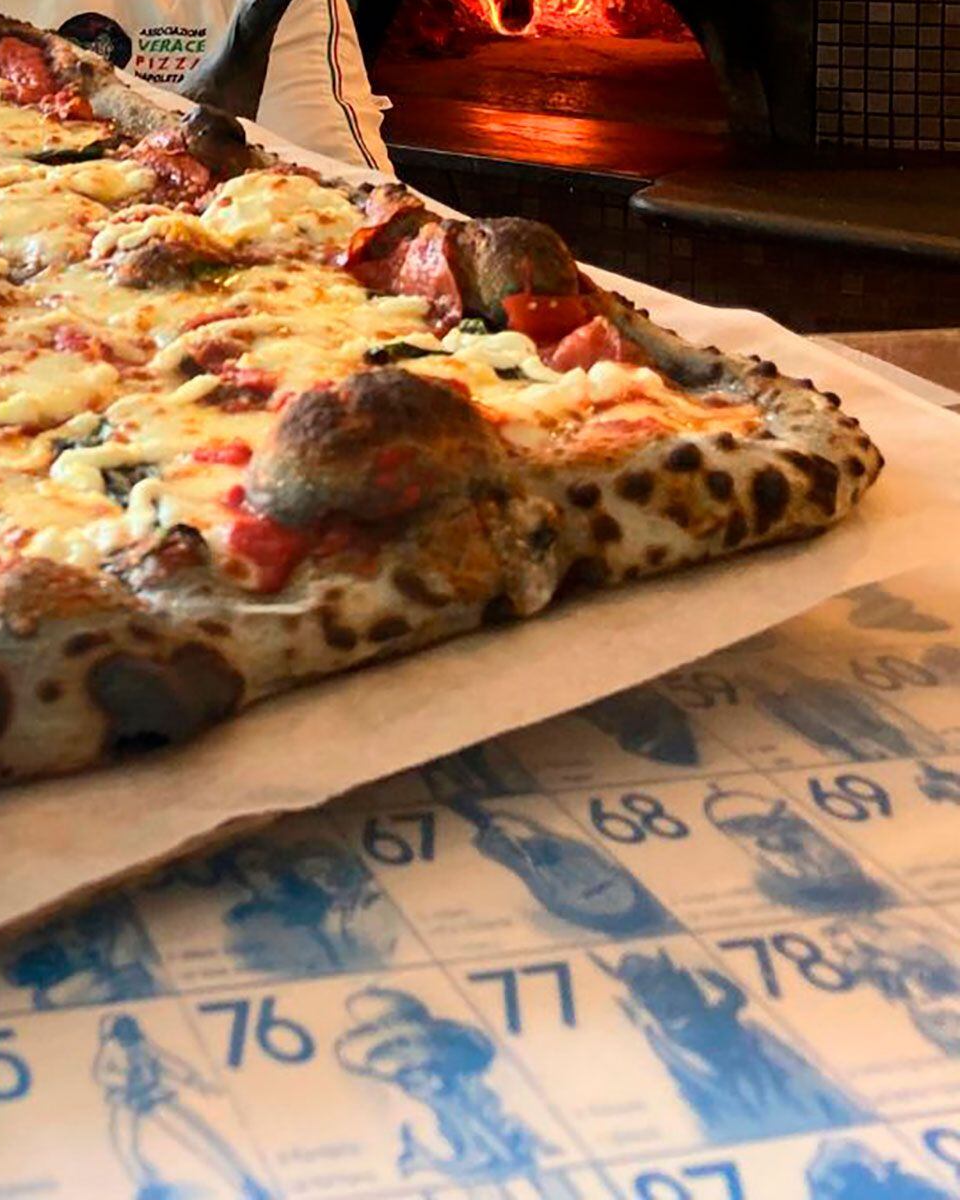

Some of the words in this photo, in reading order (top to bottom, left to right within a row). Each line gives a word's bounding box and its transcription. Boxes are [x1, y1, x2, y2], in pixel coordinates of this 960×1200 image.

[138, 38, 207, 53] VERACE
[849, 654, 939, 692] 60
[363, 811, 436, 866] 67
[589, 792, 689, 844] 68
[807, 773, 892, 822] 69
[197, 996, 316, 1069] 76
[467, 961, 577, 1035] 77
[717, 932, 857, 1000] 78
